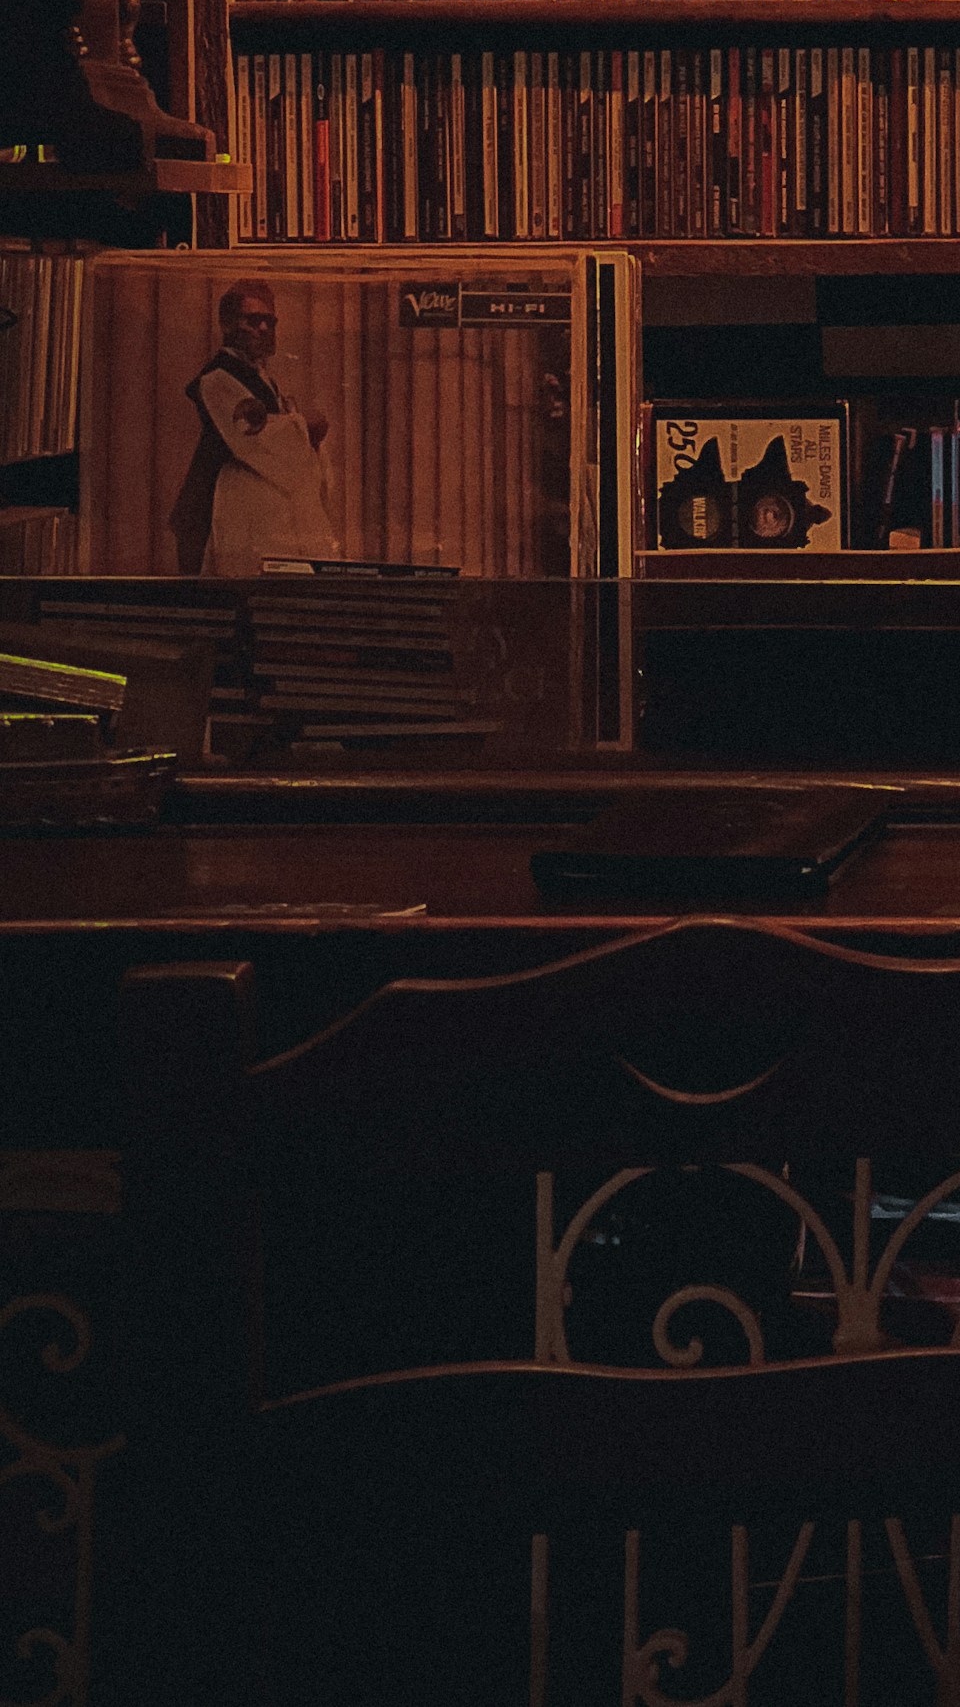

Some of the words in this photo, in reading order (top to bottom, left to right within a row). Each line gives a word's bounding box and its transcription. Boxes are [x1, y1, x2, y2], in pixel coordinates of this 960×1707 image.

[490, 303, 546, 314] HI-FI
[790, 425, 803, 464] STARS
[804, 440, 817, 461] ALL
